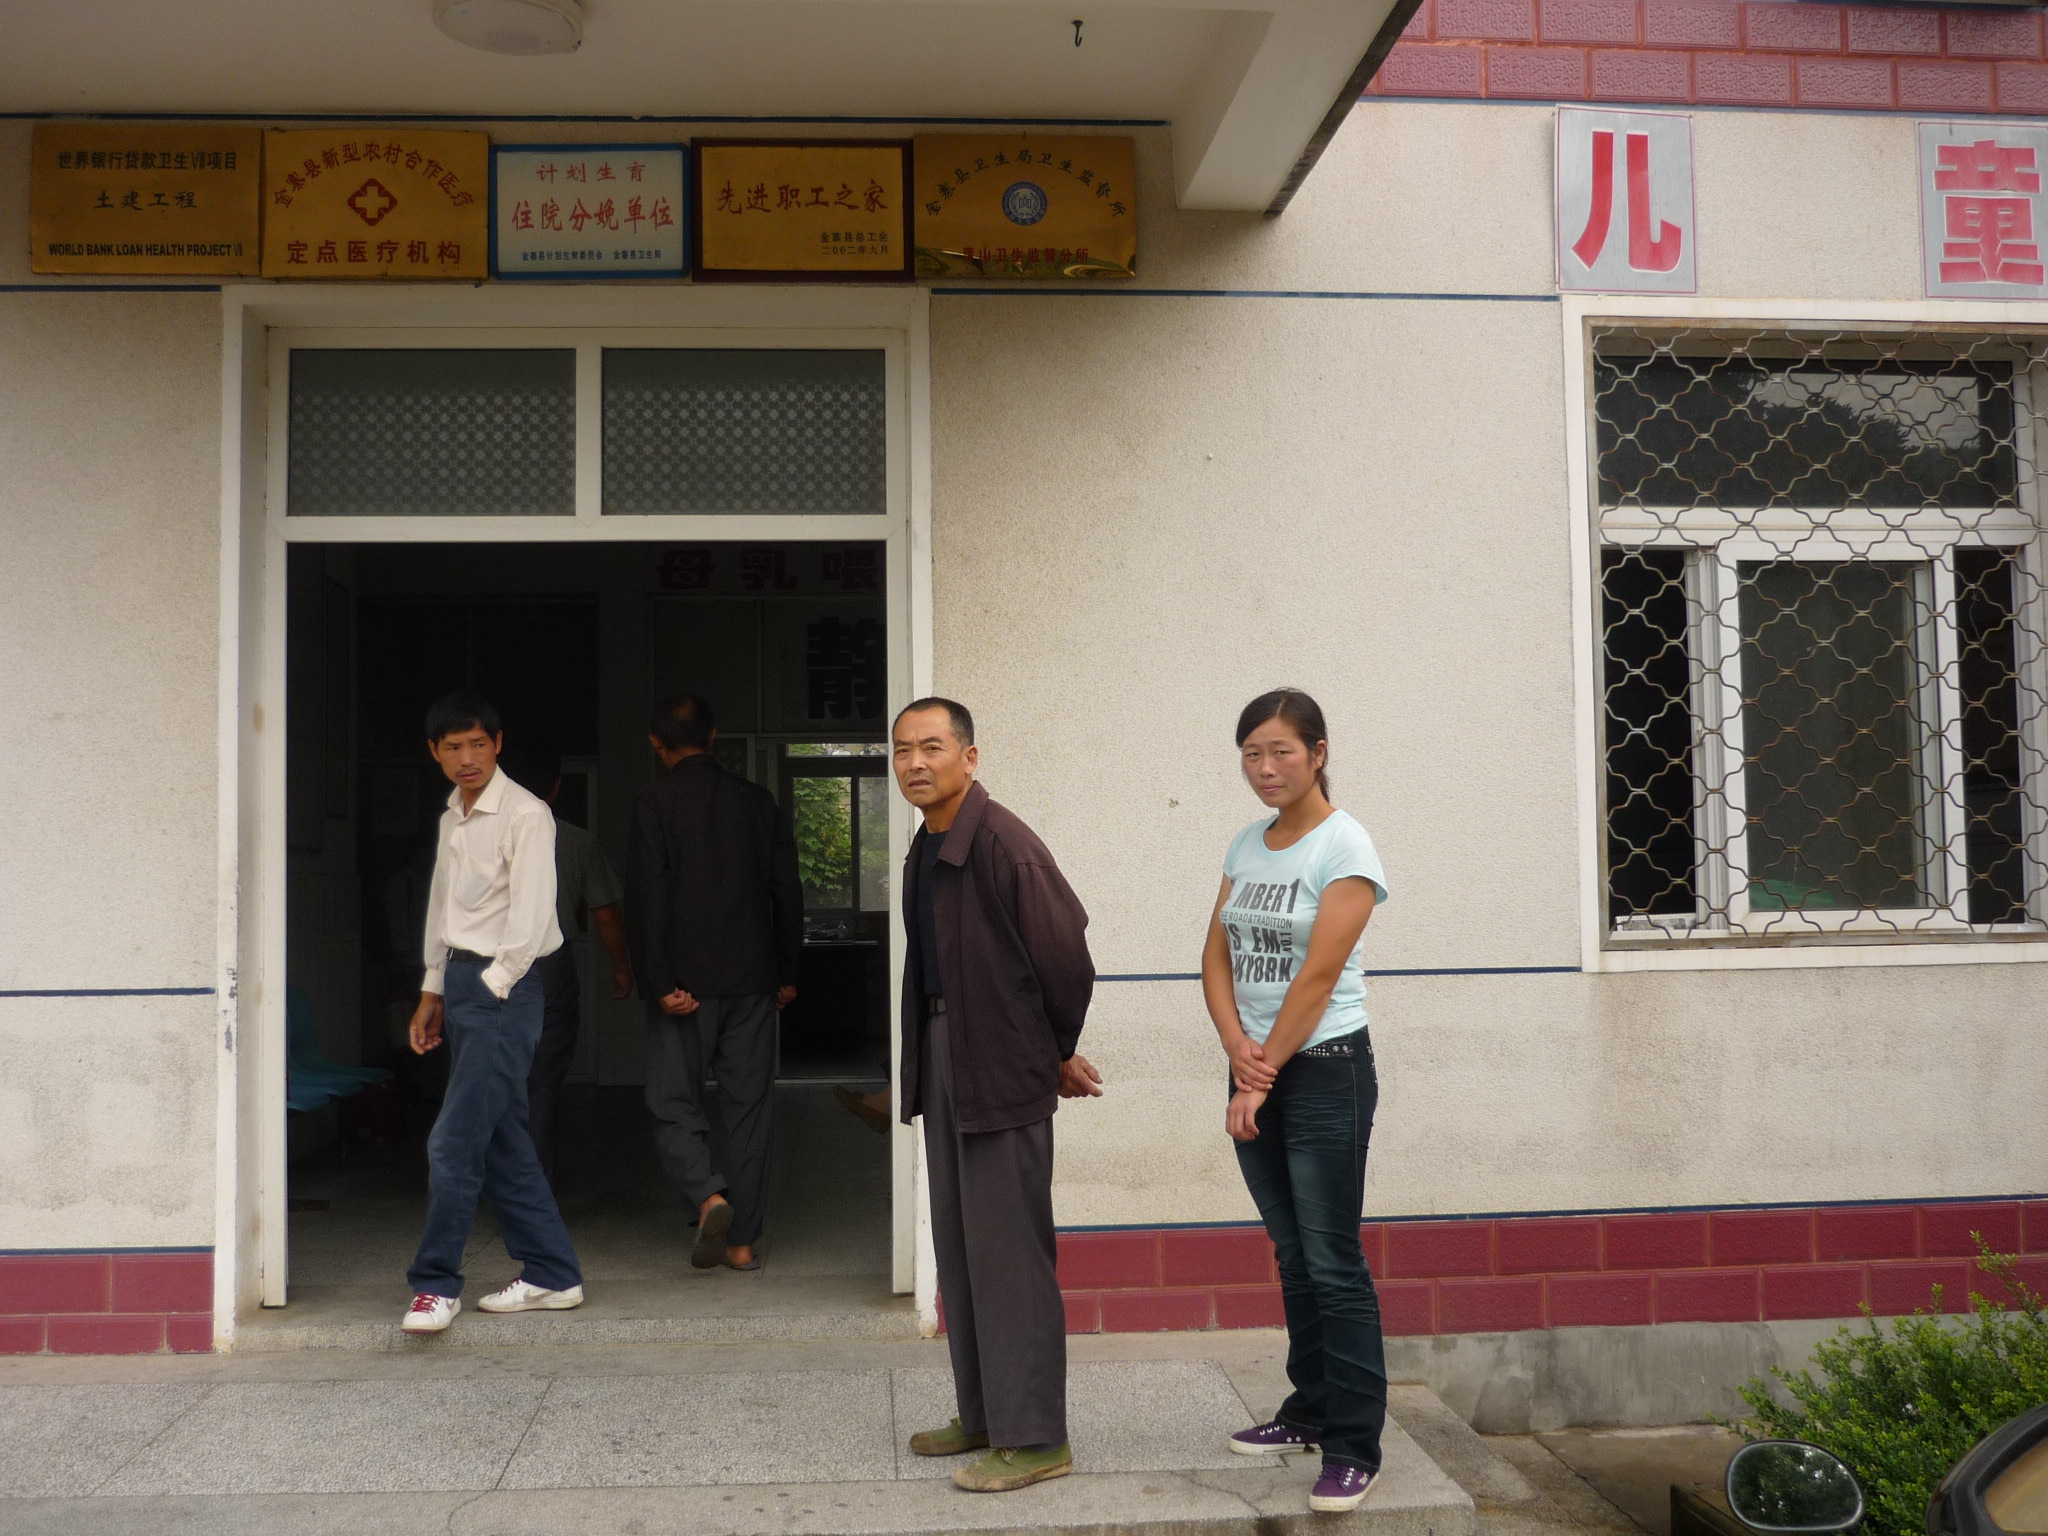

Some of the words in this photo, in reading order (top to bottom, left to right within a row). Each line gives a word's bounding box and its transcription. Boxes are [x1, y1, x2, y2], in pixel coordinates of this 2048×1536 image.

[274, 141, 475, 208] 金寨县新型农村合作医疗
[536, 162, 646, 183] 计划生育
[94, 190, 197, 211] 土建工程
[717, 179, 888, 214] 先进职工之家
[512, 195, 674, 233] 住院分娩单位
[820, 231, 888, 243] 金寨县总工会
[49, 243, 84, 256] WORLD
[87, 243, 113, 256] BANK
[116, 243, 142, 256] LOAN
[146, 243, 184, 256] HEALTH
[187, 243, 232, 257] PROJECT
[287, 240, 461, 265] 定点医疗机构
[521, 250, 603, 262] 金寨县计划生育委员会
[613, 249, 662, 261] 金寨县卫生局
